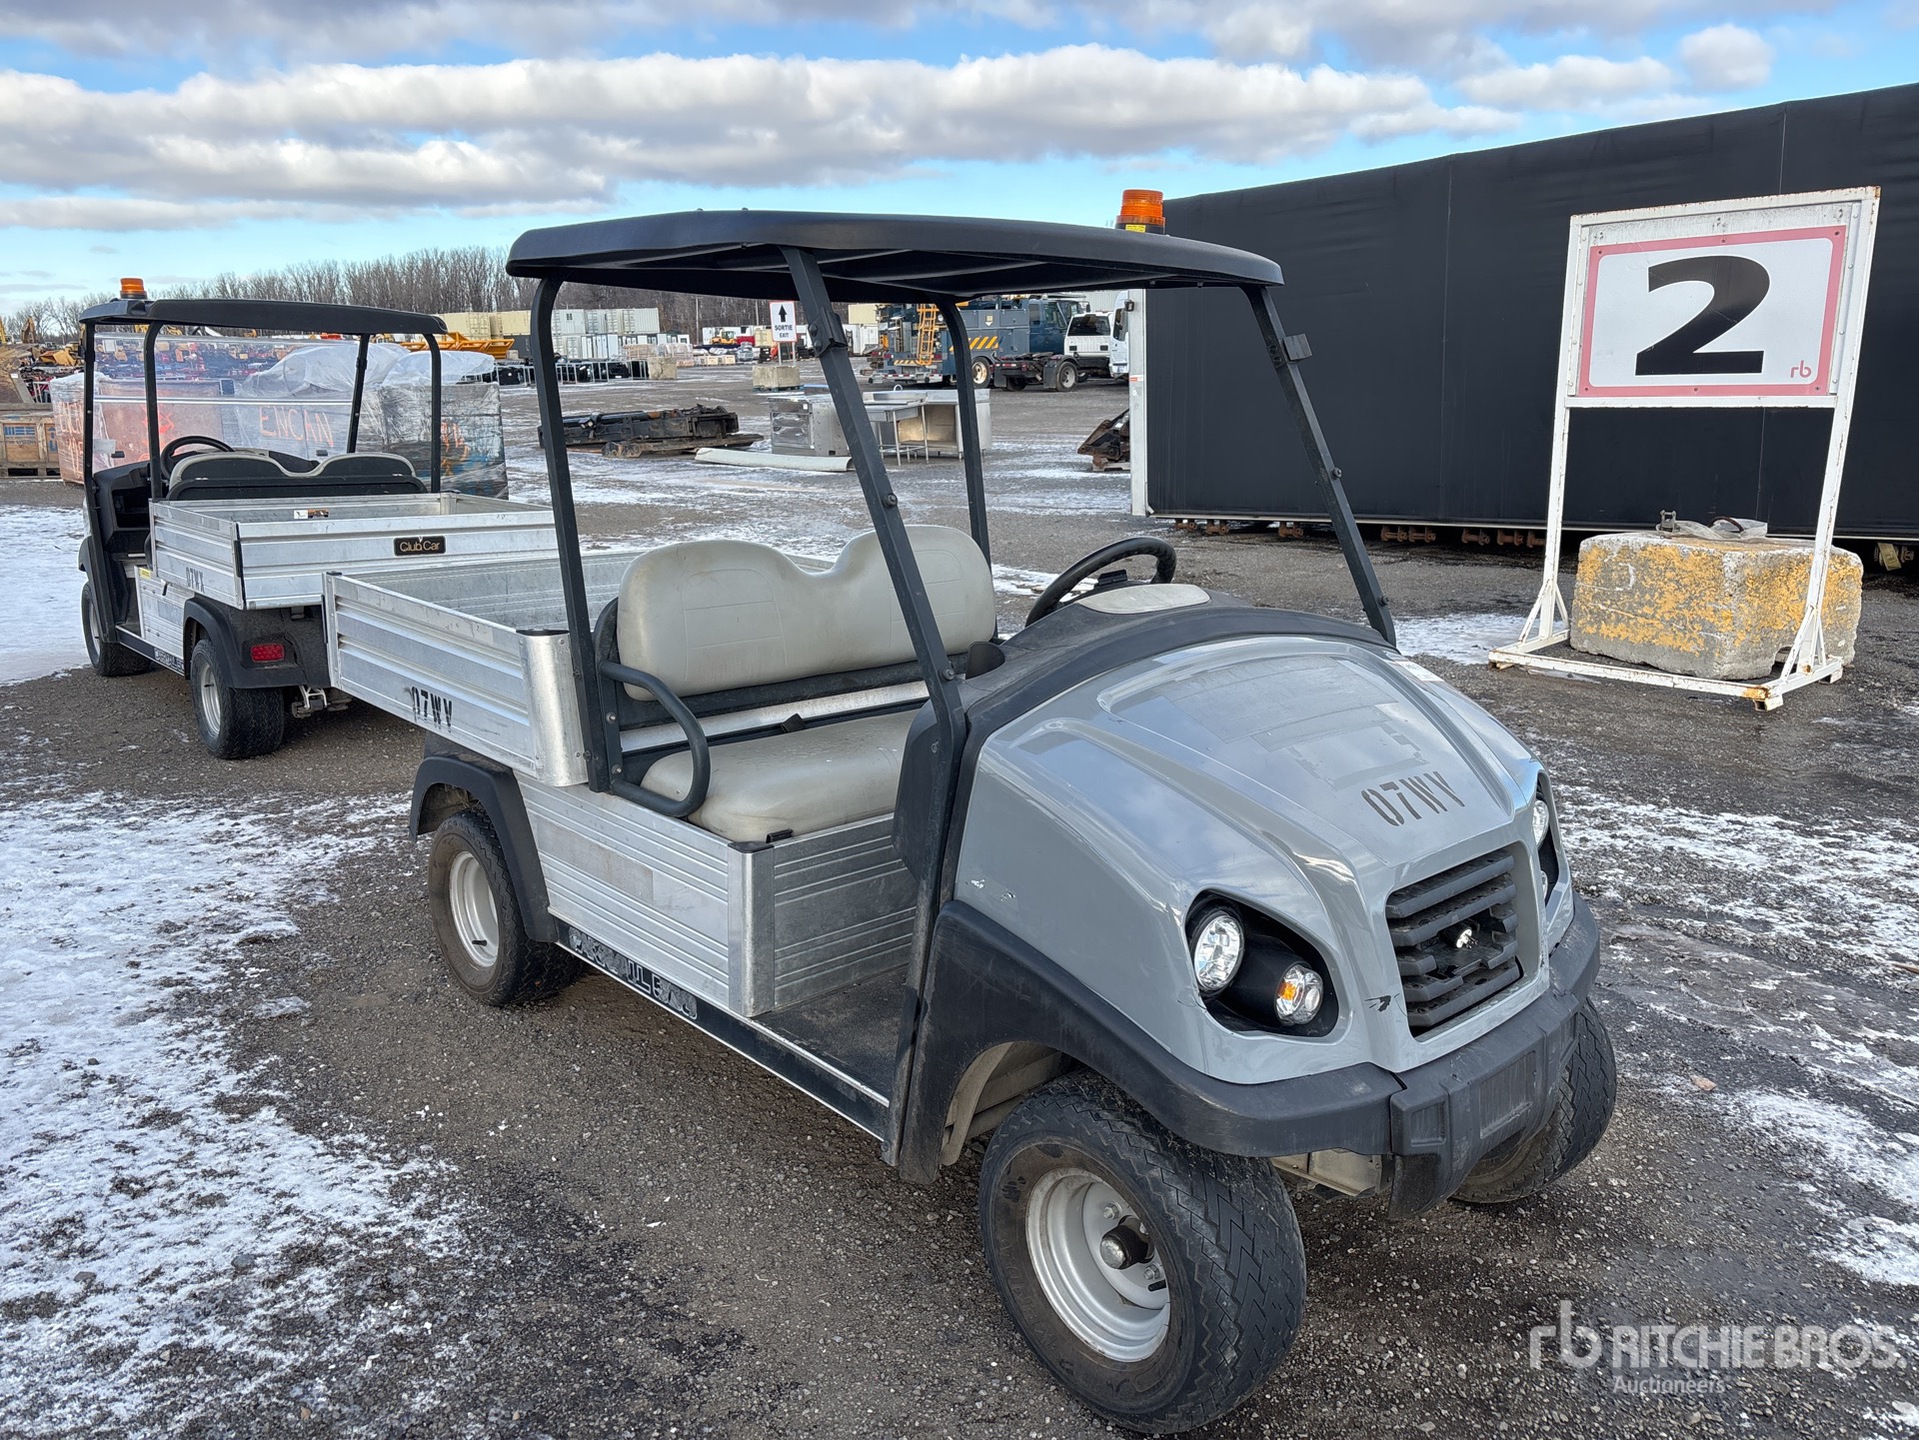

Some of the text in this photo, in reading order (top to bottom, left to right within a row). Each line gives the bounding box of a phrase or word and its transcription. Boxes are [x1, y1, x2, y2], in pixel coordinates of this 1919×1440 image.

[1635, 255, 1770, 376] 2
[1790, 360, 1812, 378] rb
[259, 405, 334, 447] ENCAN
[400, 540, 440, 552] Club Car
[1361, 771, 1465, 827] 07WY
